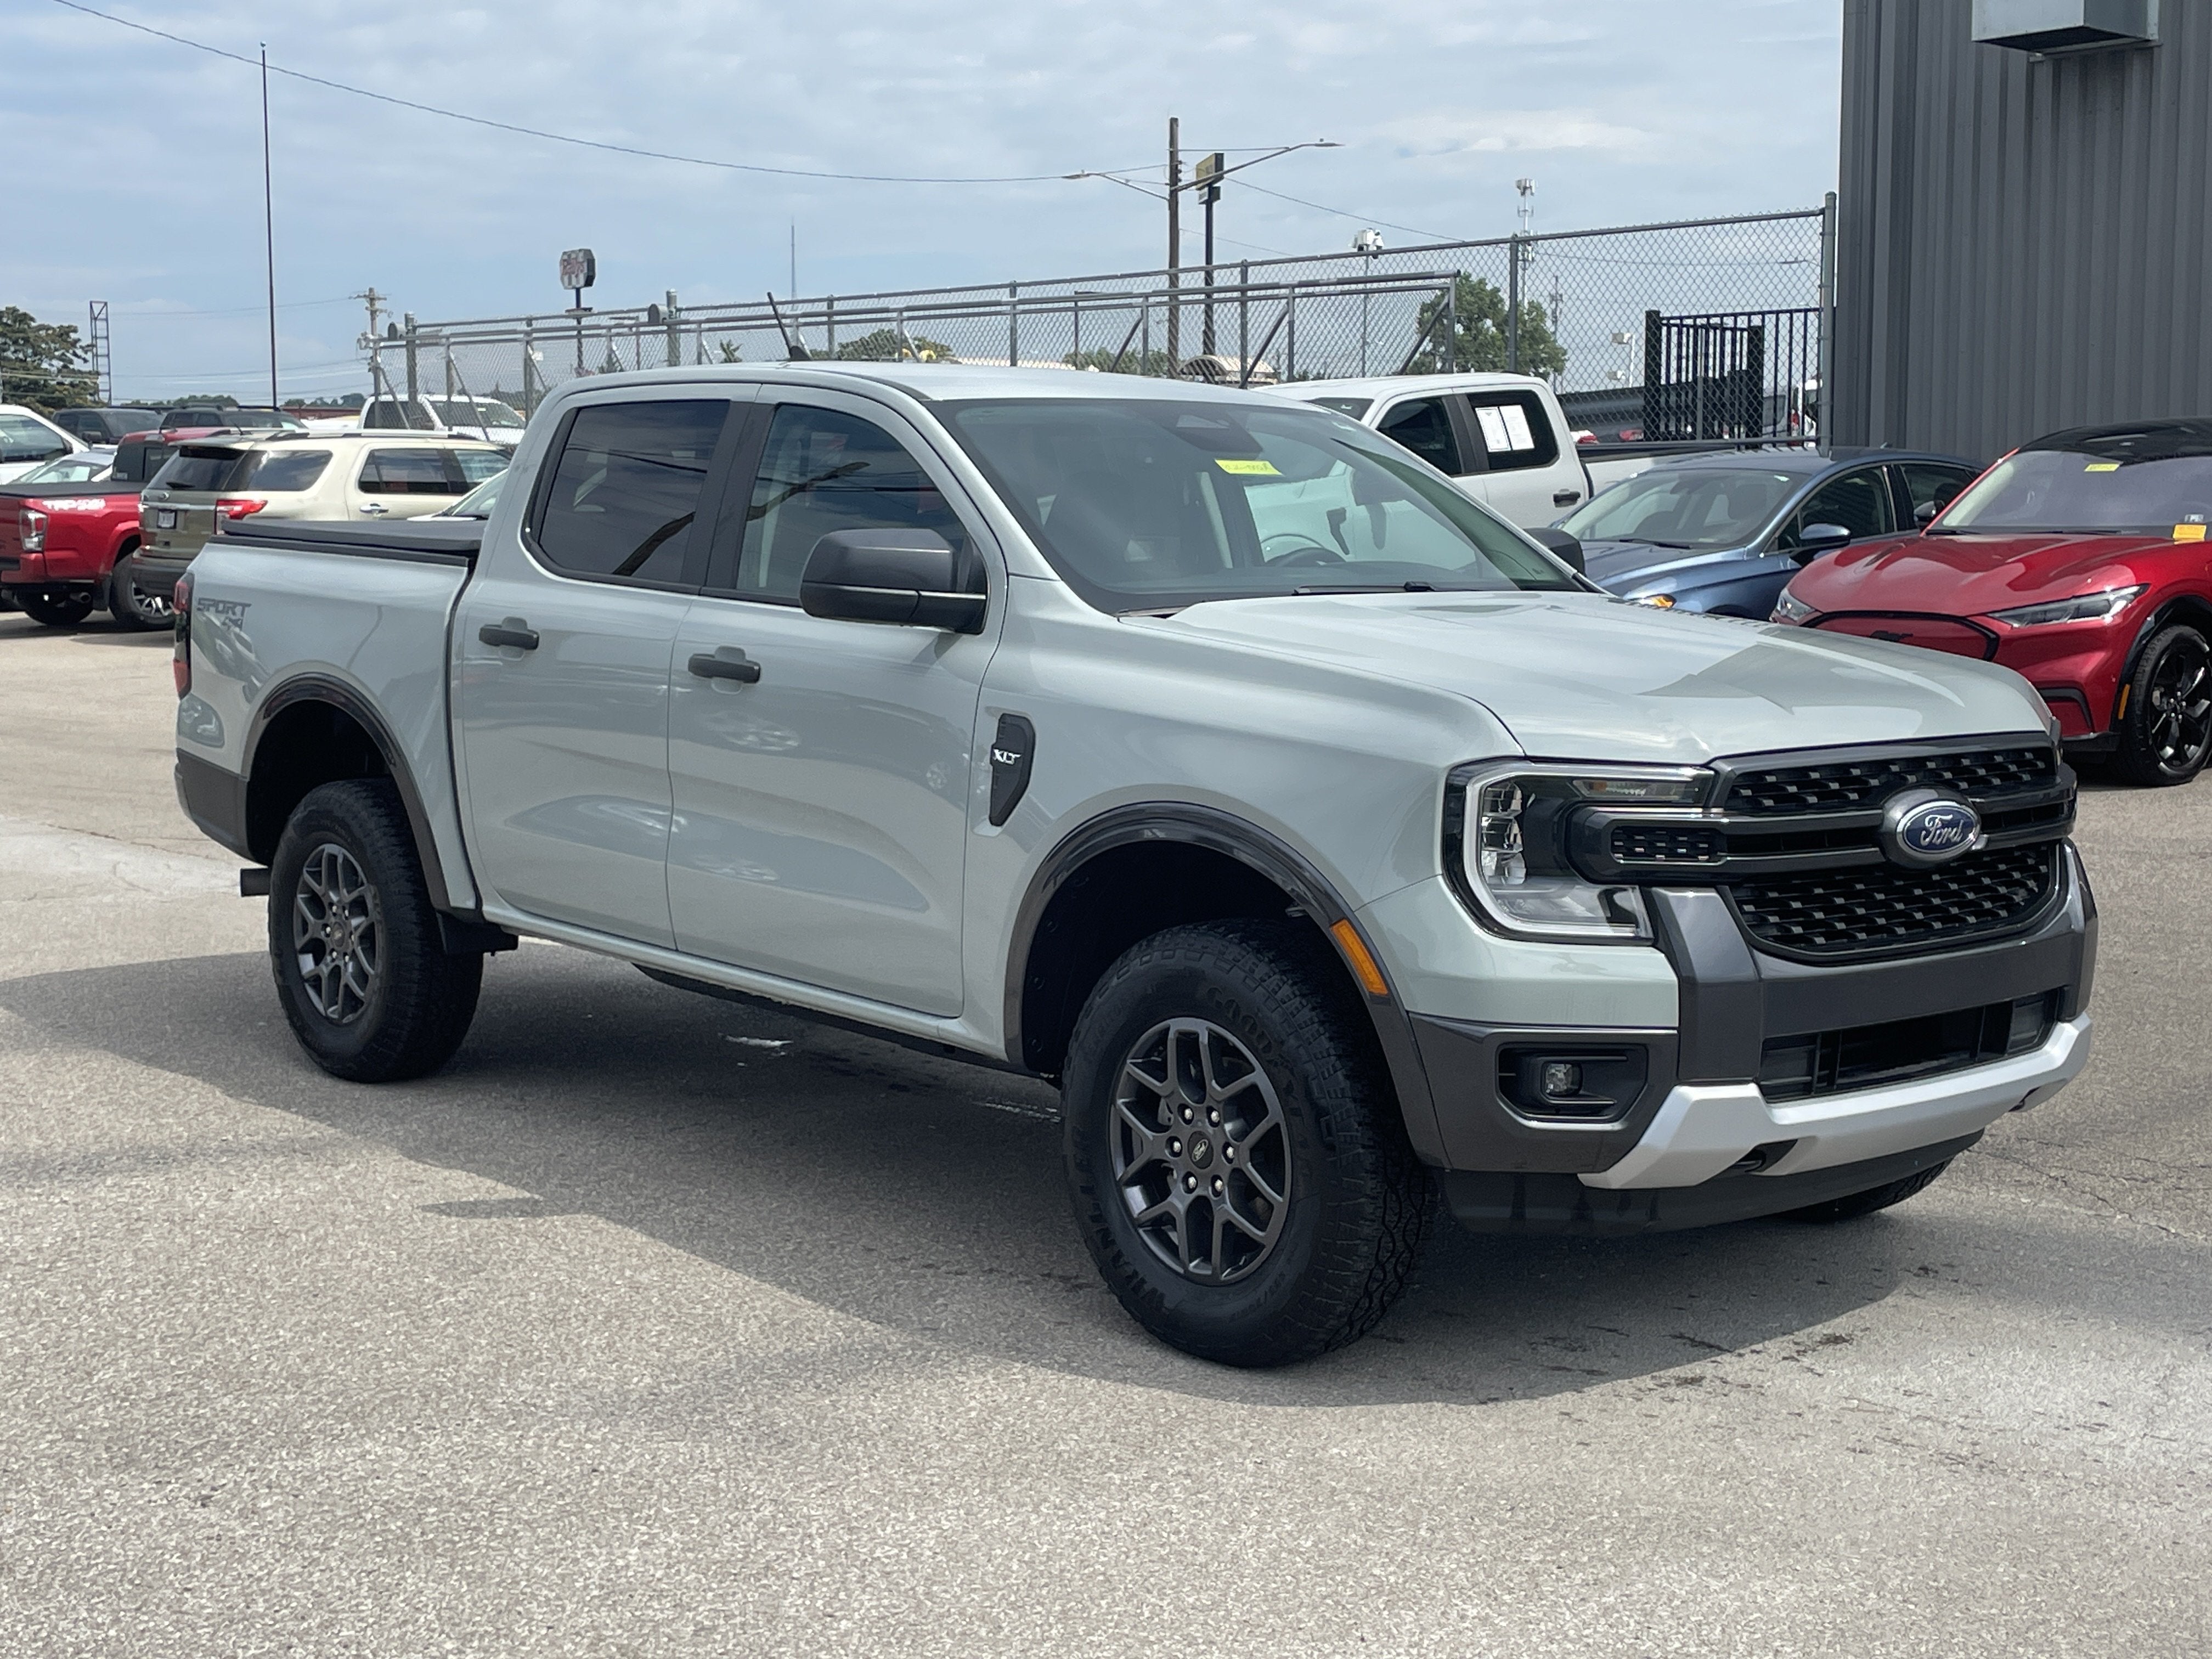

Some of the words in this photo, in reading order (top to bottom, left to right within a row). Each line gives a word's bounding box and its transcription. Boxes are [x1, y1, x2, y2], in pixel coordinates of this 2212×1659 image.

[196, 597, 252, 617] SPORT
[992, 748, 1022, 765] XLT
[1921, 814, 1963, 846] Ford
